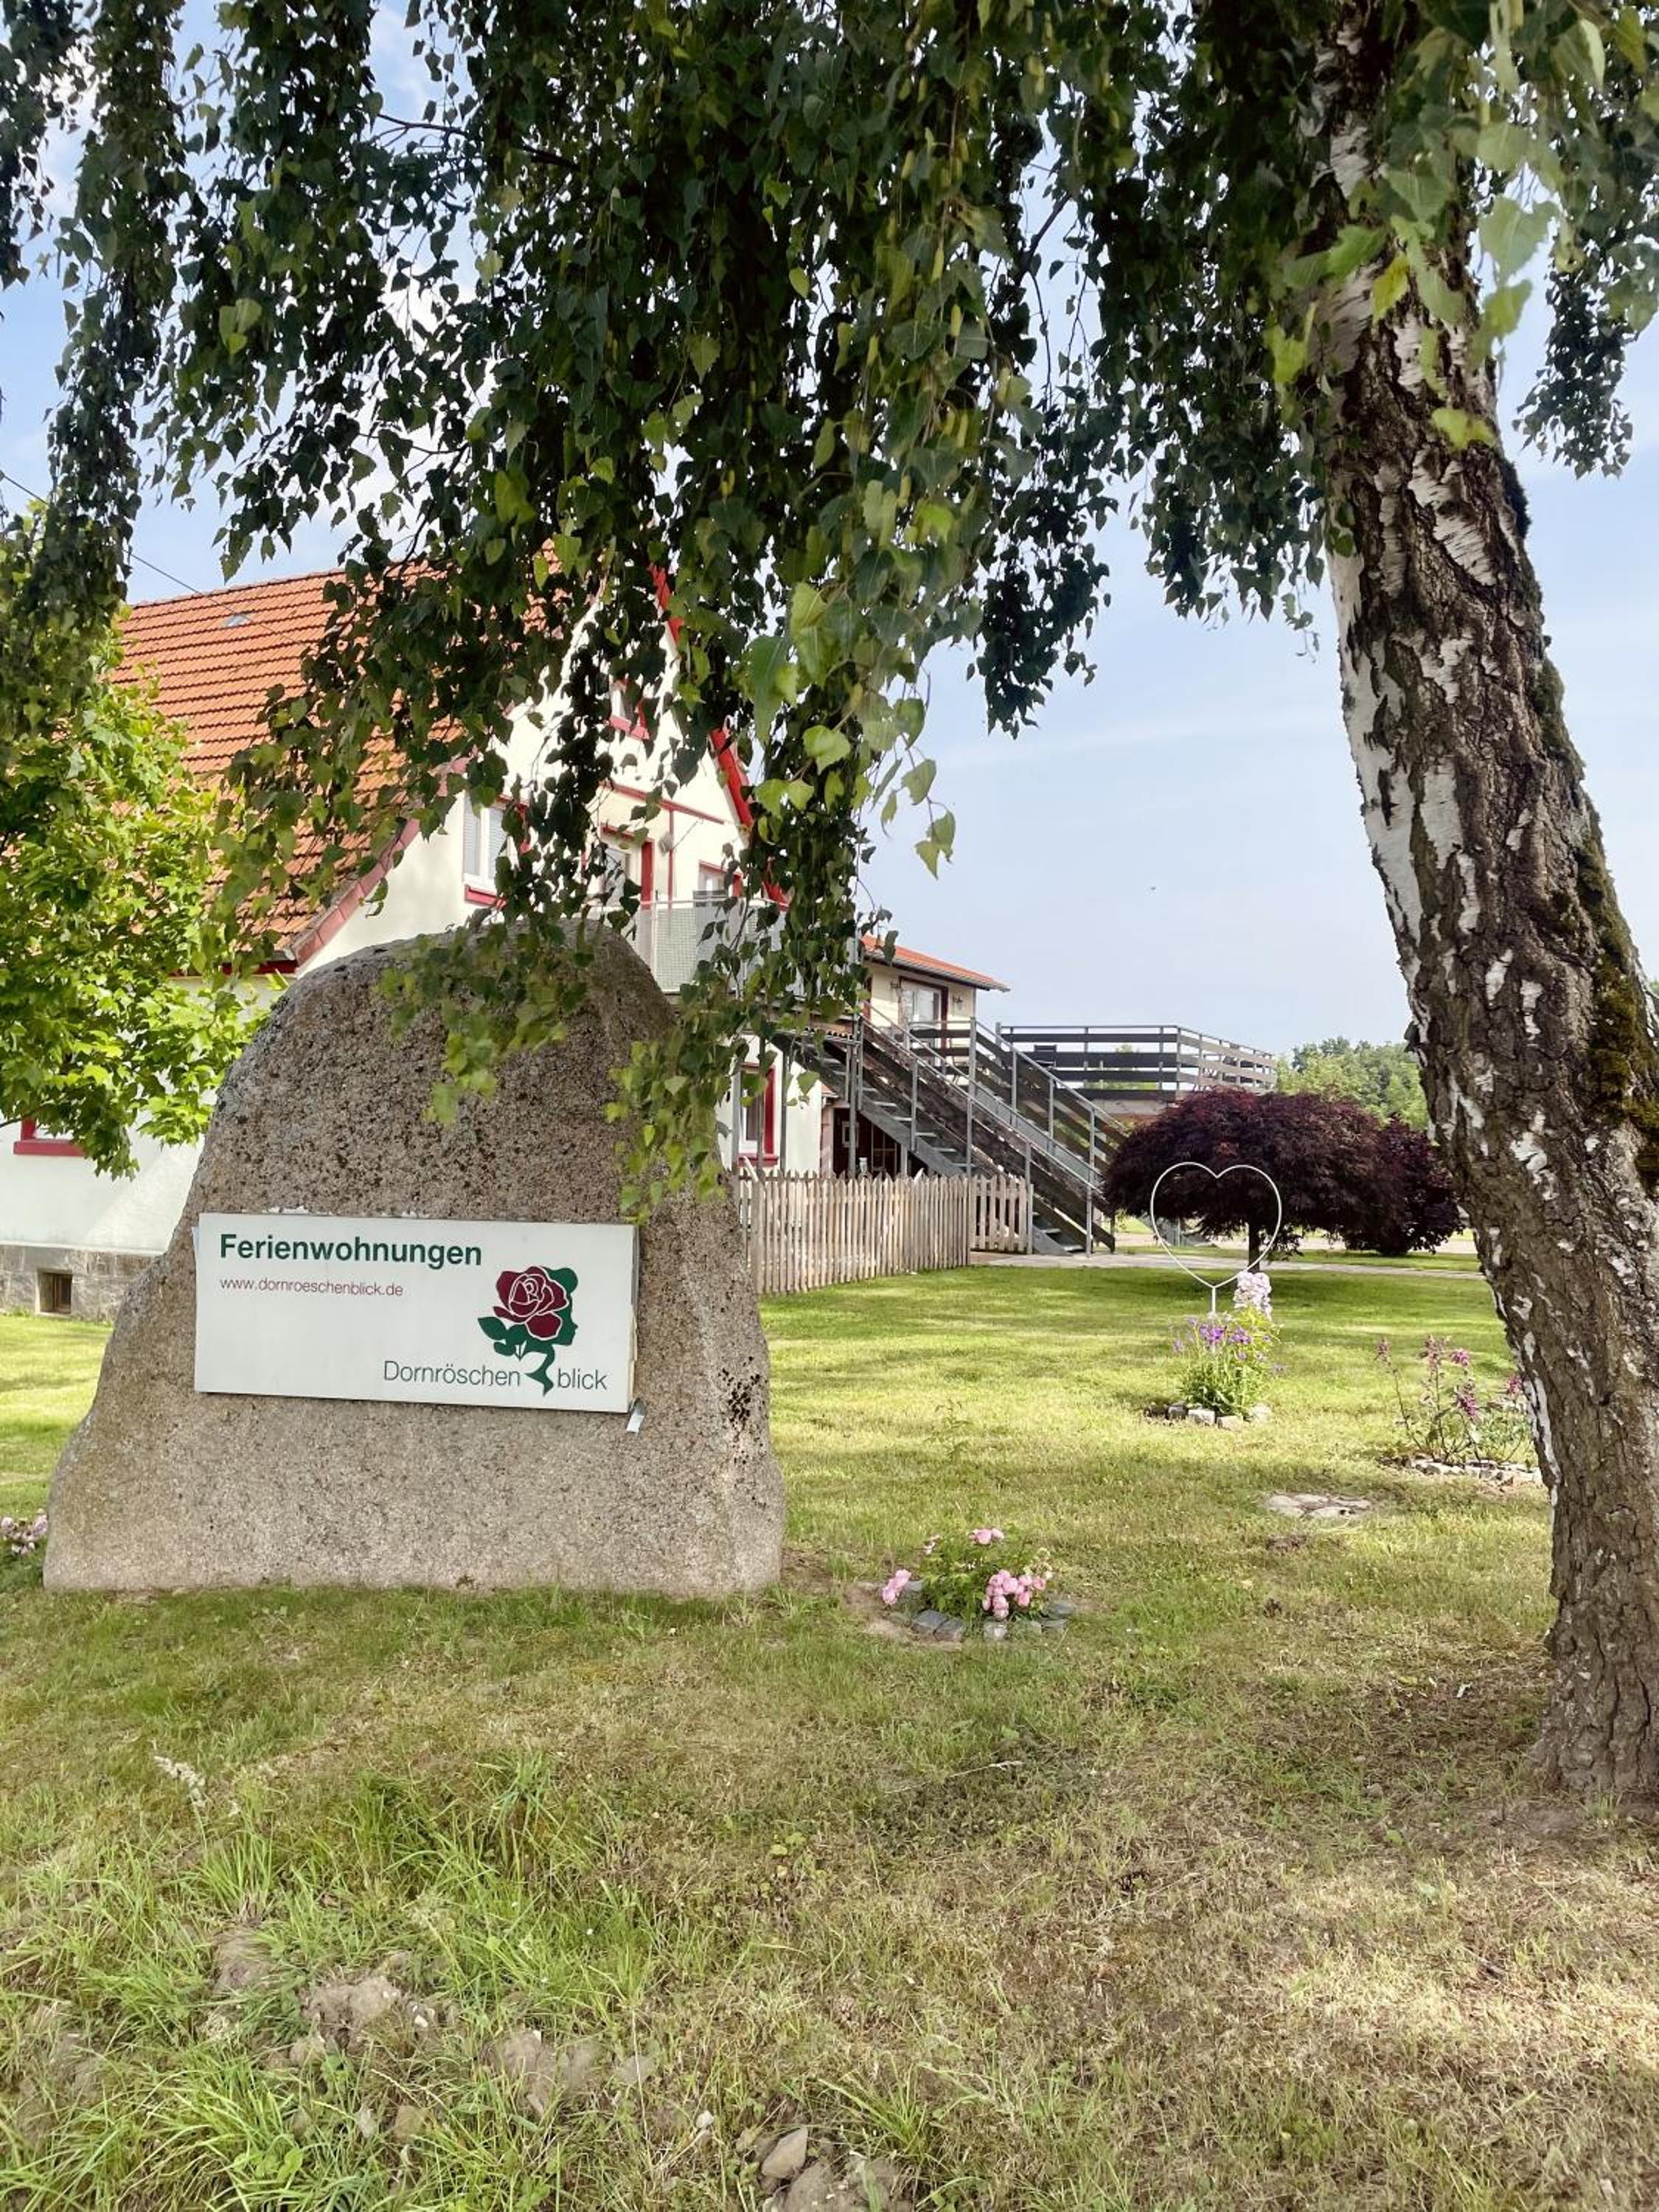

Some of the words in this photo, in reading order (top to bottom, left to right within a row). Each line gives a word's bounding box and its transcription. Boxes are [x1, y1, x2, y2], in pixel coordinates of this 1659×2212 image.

[220, 1233, 482, 1270] Ferienwohnungen
[219, 1276, 403, 1297] www.dornroeschenblick.de
[383, 1360, 521, 1387] Dornröschen
[557, 1367, 608, 1391] blick
